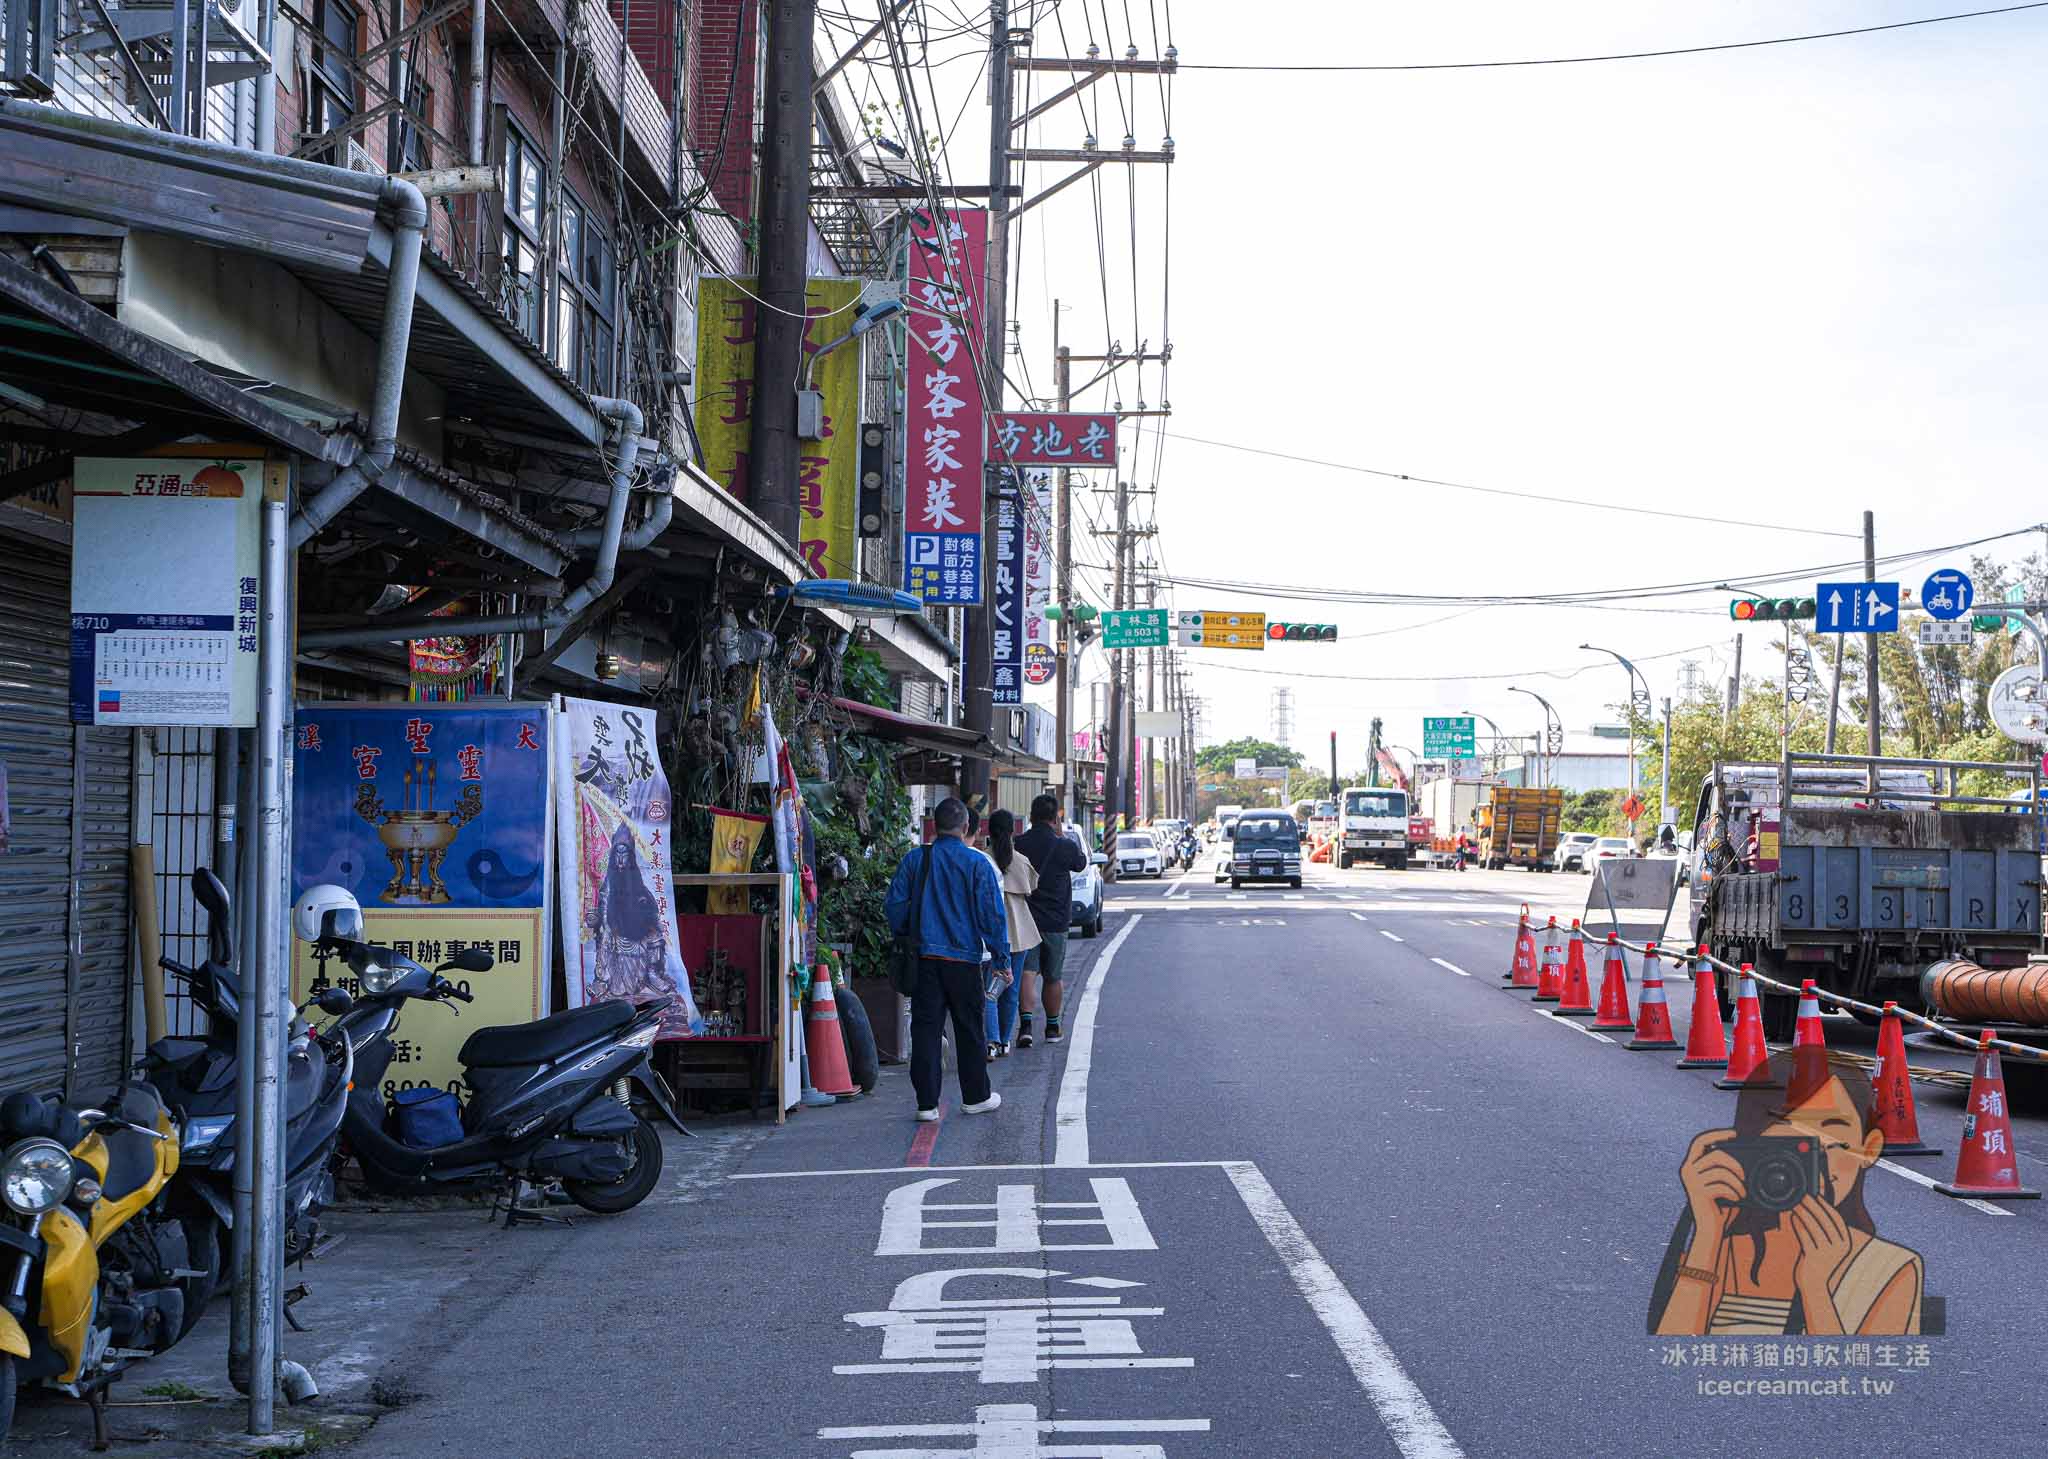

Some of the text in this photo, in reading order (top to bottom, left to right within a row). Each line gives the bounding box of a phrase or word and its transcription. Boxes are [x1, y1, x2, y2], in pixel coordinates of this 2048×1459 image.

[921, 223, 972, 530] 老地方客家菜
[993, 419, 1110, 458] 老地方
[133, 474, 209, 497] 亞通巴士
[915, 537, 934, 562] P
[944, 537, 959, 600] 對面巷子
[960, 537, 975, 600] 後方全家
[238, 577, 257, 654] 復興新城
[1979, 1090, 2007, 1156] 埔頂
